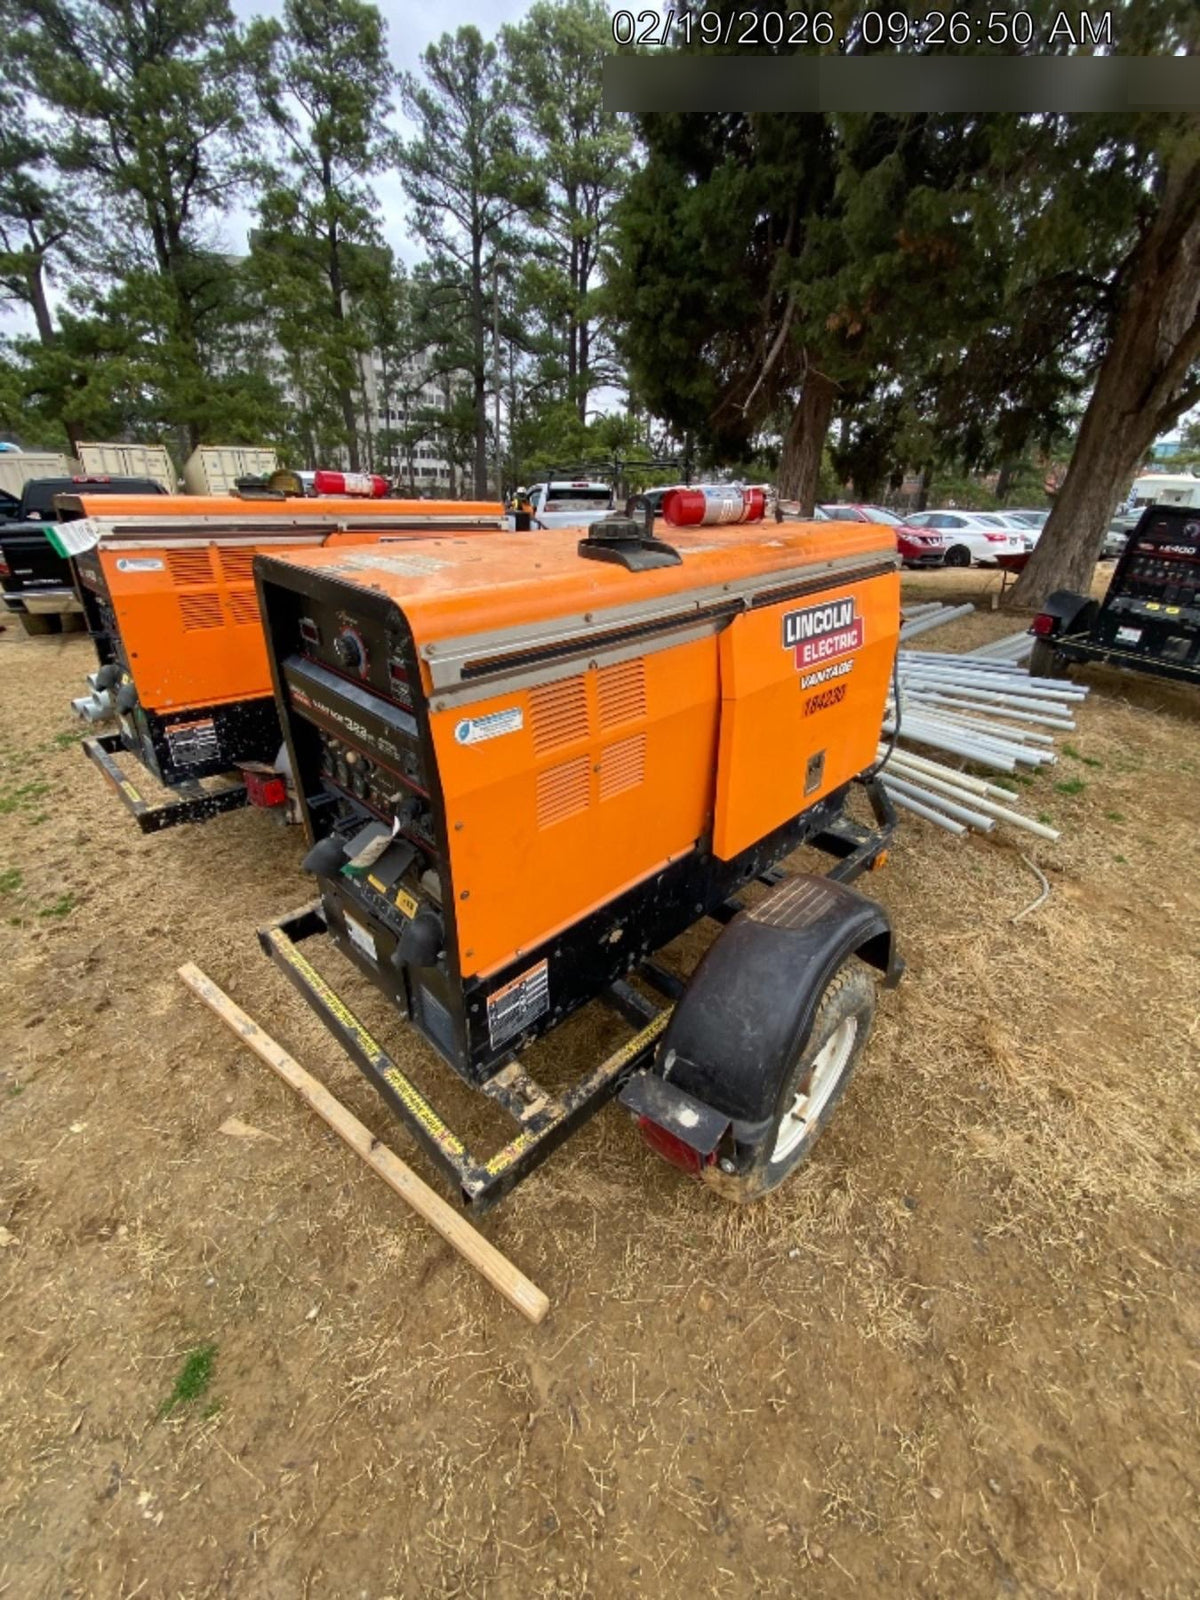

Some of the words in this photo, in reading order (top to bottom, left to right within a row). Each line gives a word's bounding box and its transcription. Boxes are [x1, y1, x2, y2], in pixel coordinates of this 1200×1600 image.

[787, 602, 853, 642] LINCOLN
[803, 630, 858, 662] ELECTRIC
[801, 660, 854, 689] VANTAGE
